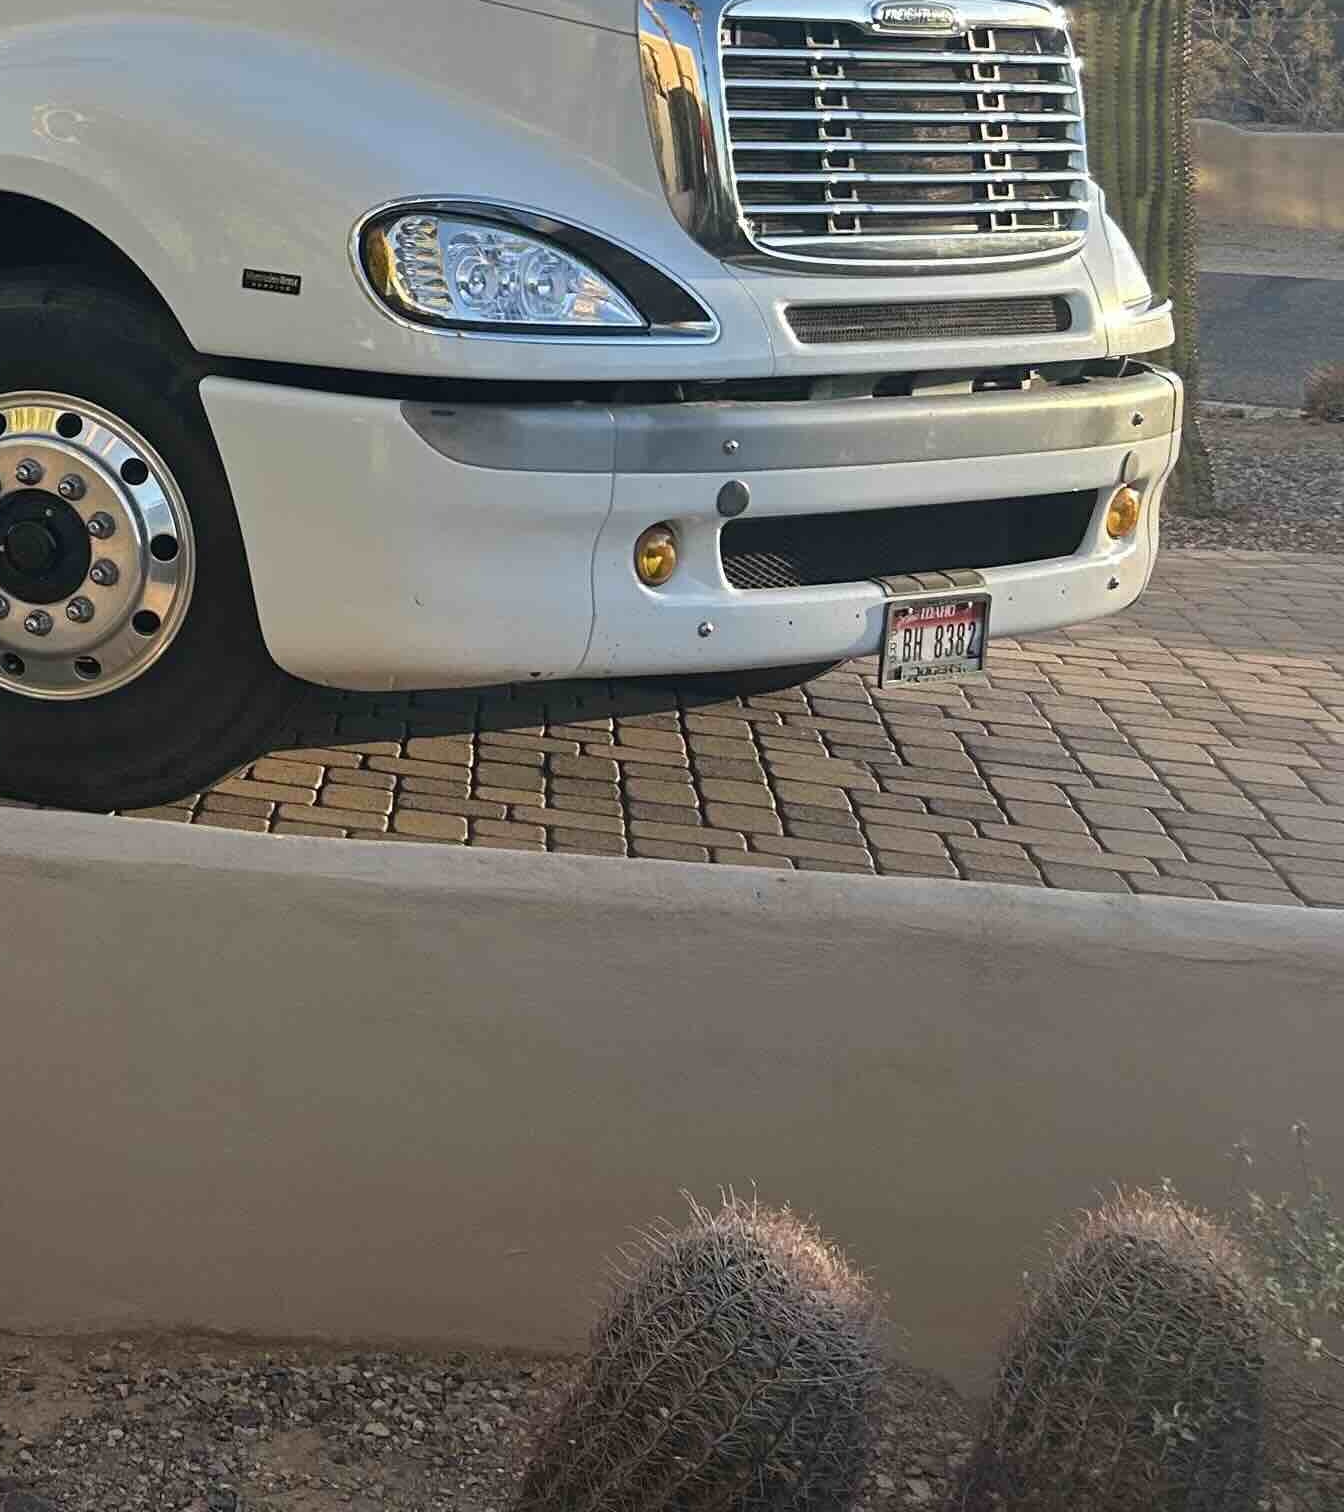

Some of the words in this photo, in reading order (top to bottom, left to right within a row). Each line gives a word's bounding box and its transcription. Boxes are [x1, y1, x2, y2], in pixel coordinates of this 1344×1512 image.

[920, 605, 958, 620] IDAHO
[901, 627, 923, 663] BH
[934, 621, 977, 659] 8382
